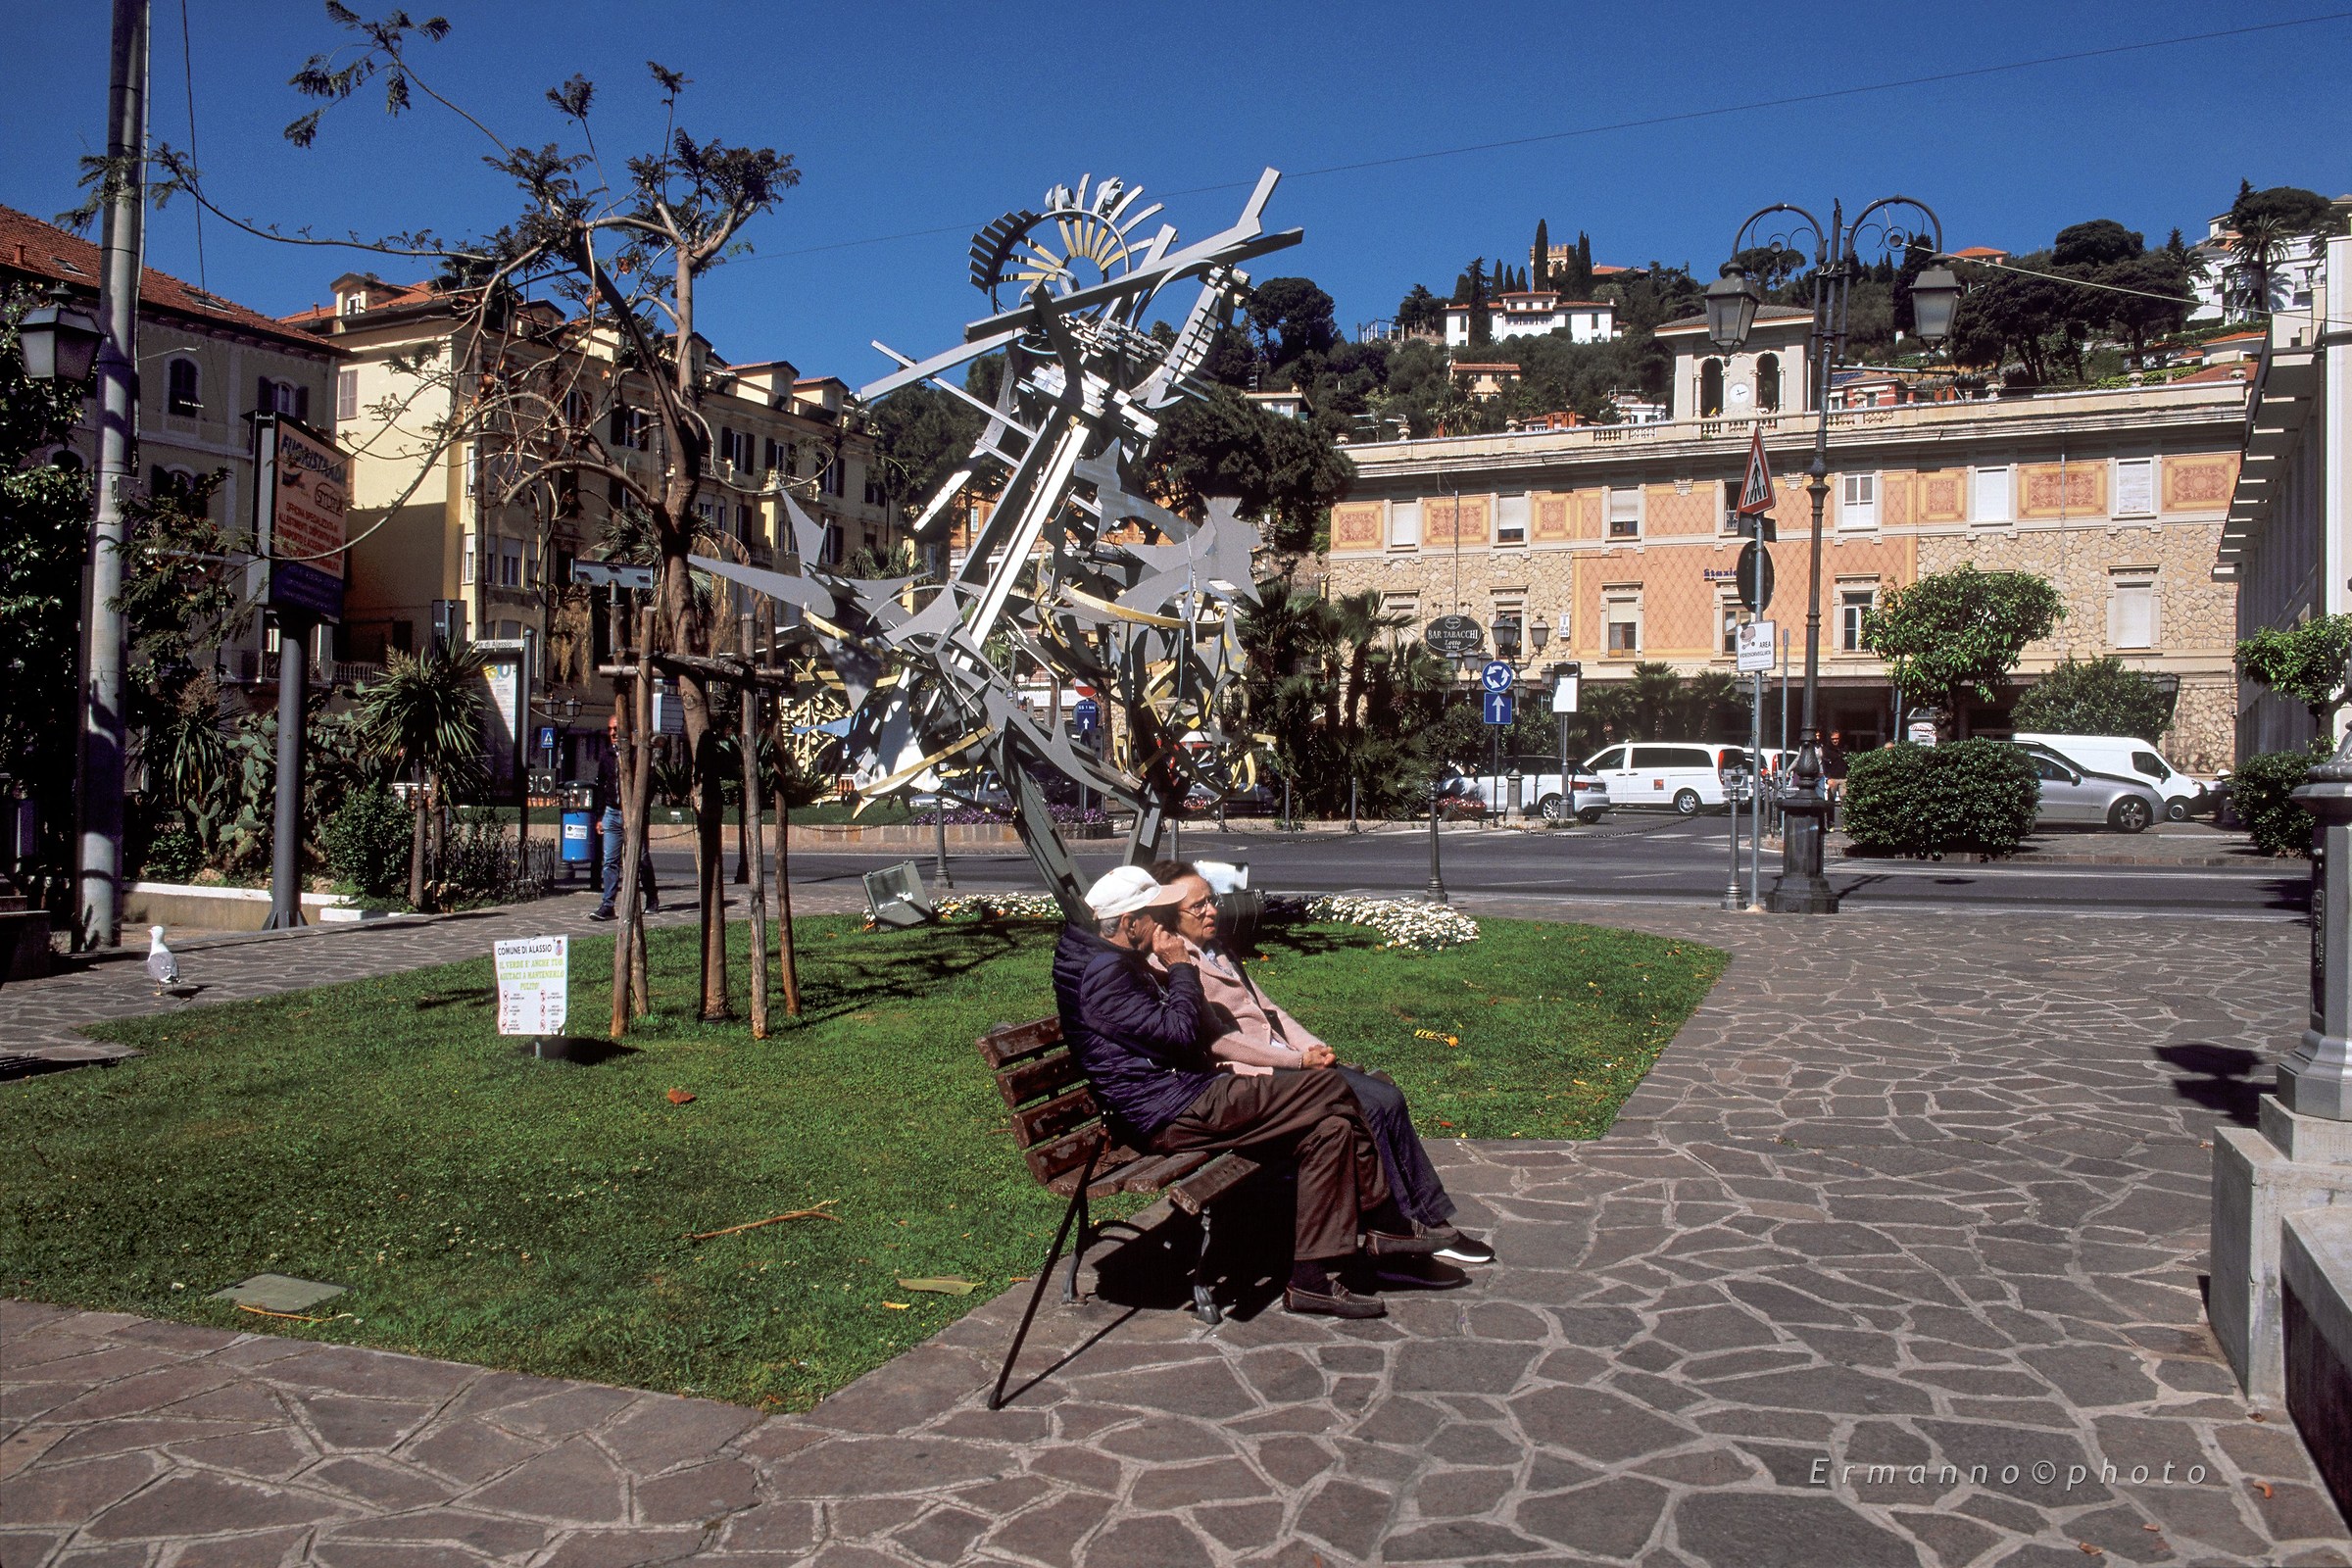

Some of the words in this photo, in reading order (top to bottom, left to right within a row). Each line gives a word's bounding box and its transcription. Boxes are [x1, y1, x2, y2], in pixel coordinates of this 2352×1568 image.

[1428, 629, 1442, 640] BAR
[1443, 629, 1478, 639] TABACCHI
[498, 946, 520, 956] COMUNE
[529, 944, 552, 953] ALASSIO
